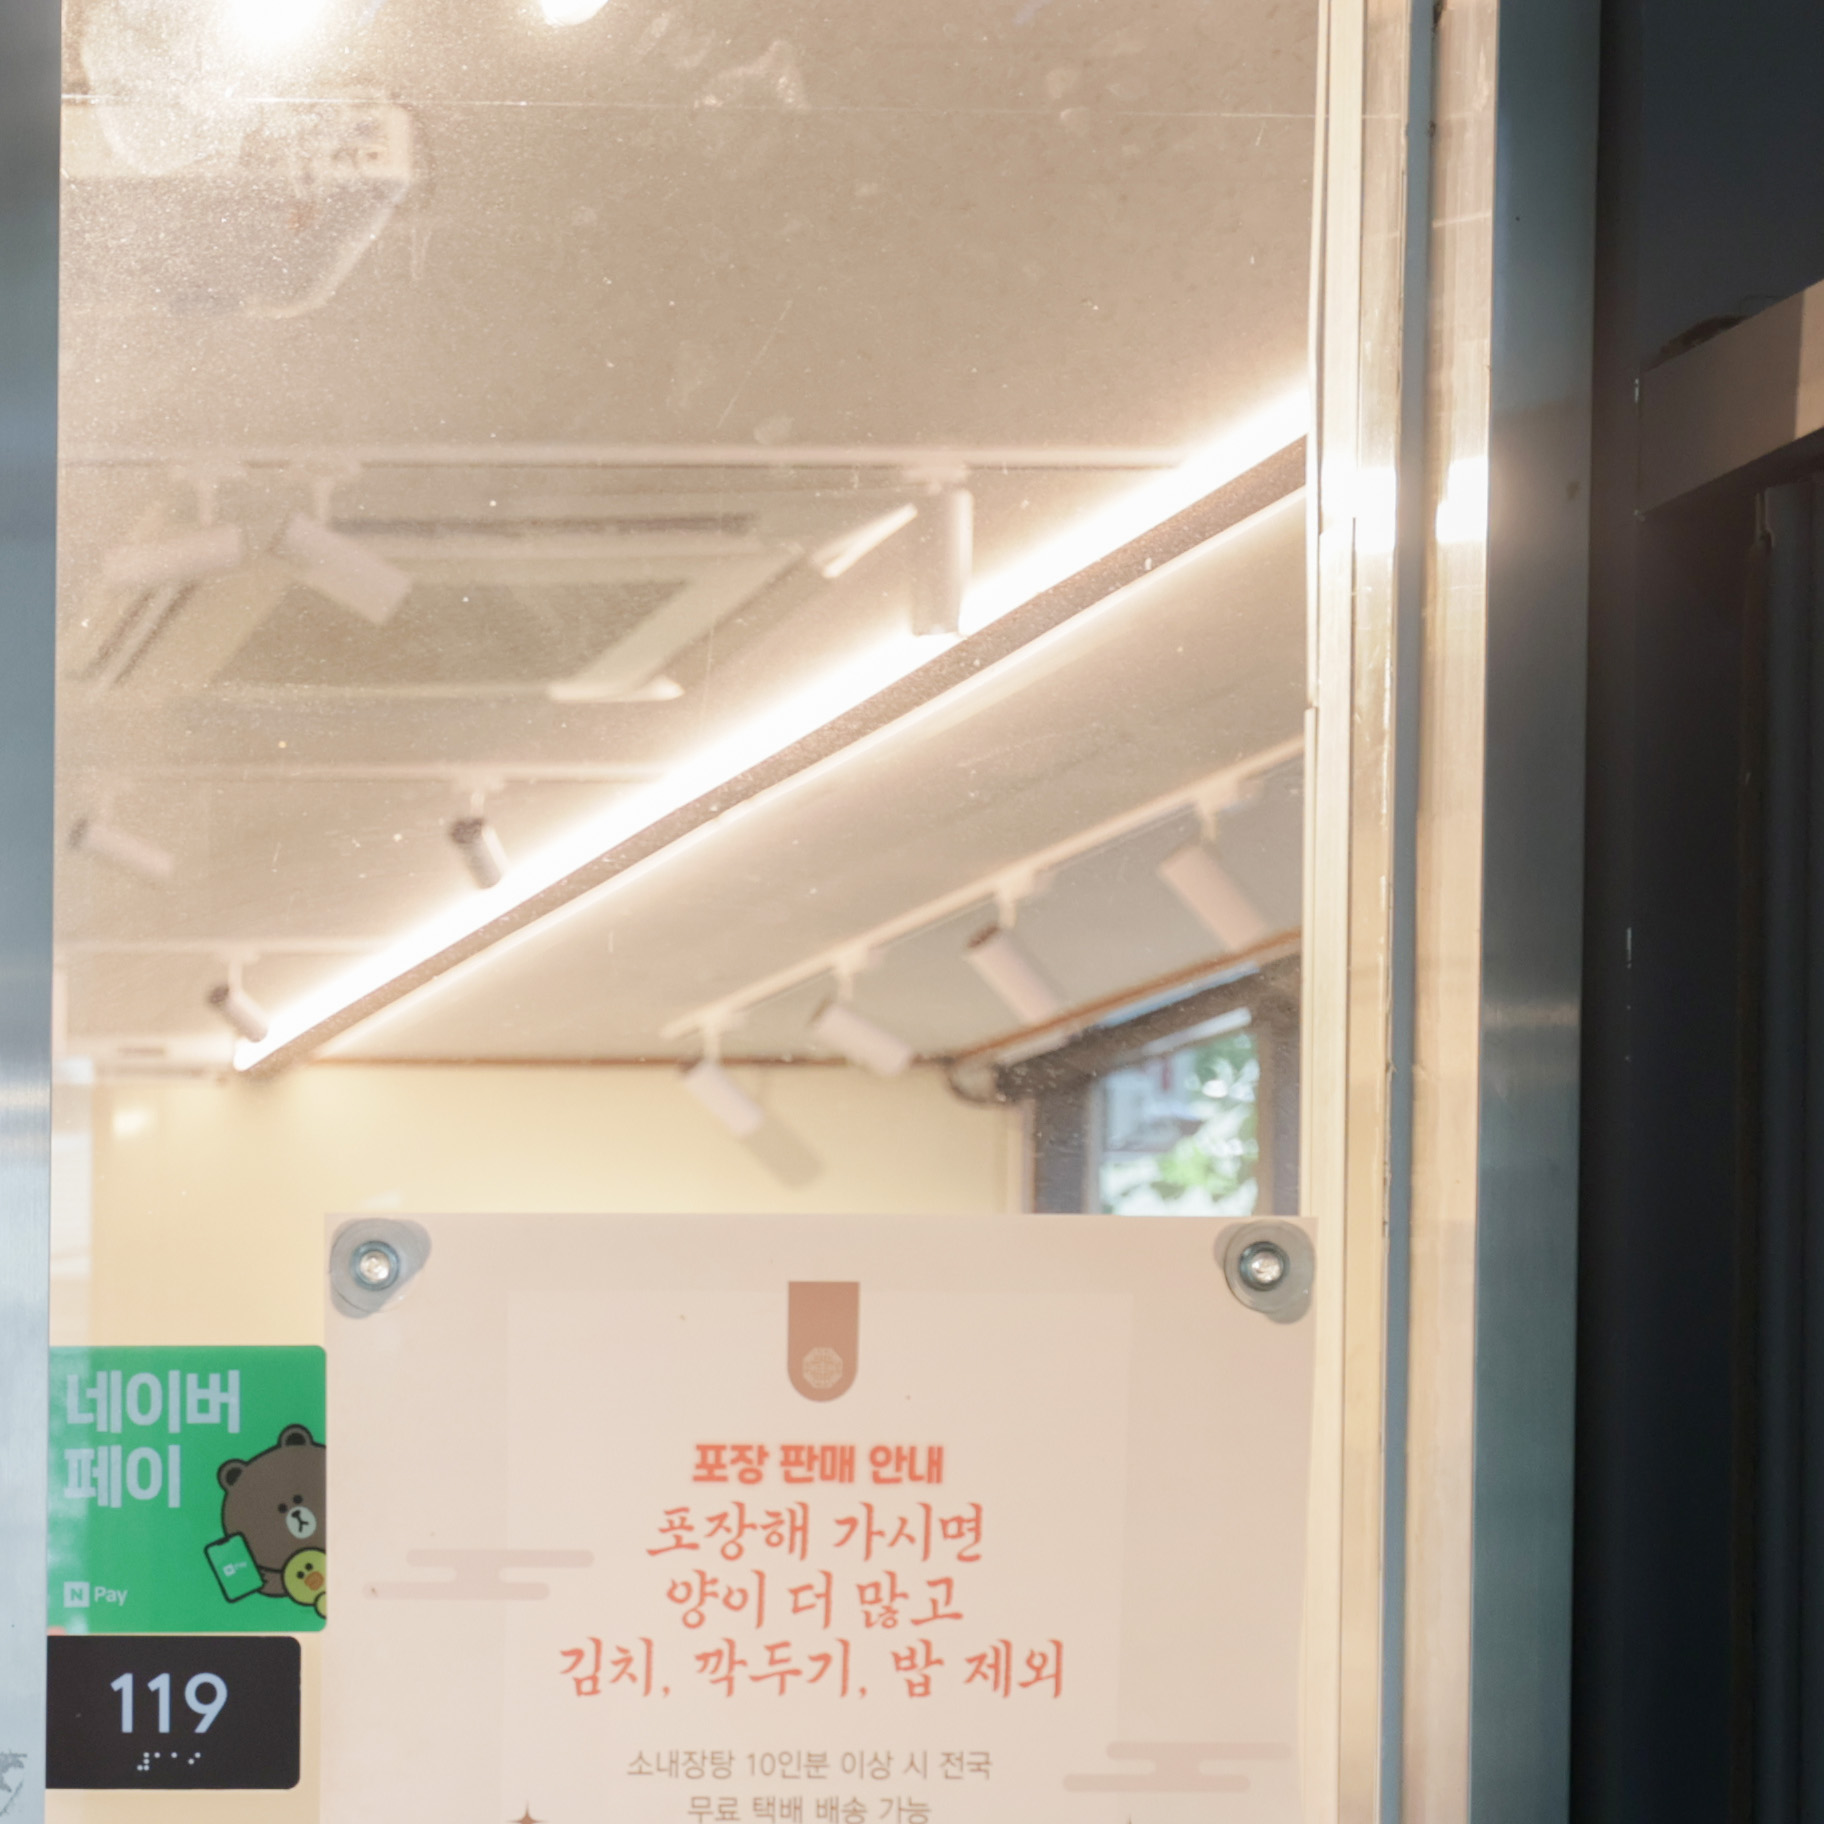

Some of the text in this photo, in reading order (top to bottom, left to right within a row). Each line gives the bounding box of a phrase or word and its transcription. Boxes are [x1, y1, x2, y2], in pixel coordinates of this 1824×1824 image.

[66, 1370, 241, 1433] 네이버
[64, 1445, 181, 1508] 페이
[692, 1444, 945, 1486] 포장 판매 안내
[646, 1502, 985, 1563] 포장해 가시면
[94, 1586, 128, 1607] Pay
[665, 1570, 965, 1631] 양이 더 많고
[559, 1637, 1065, 1699] 김치, 깍두기, 밥 제외
[110, 1673, 229, 1734] 119
[627, 1750, 993, 1781] 소내장탕 10인분 이상 시 전국
[687, 1796, 741, 1824] 무료
[751, 1796, 804, 1824] 택배
